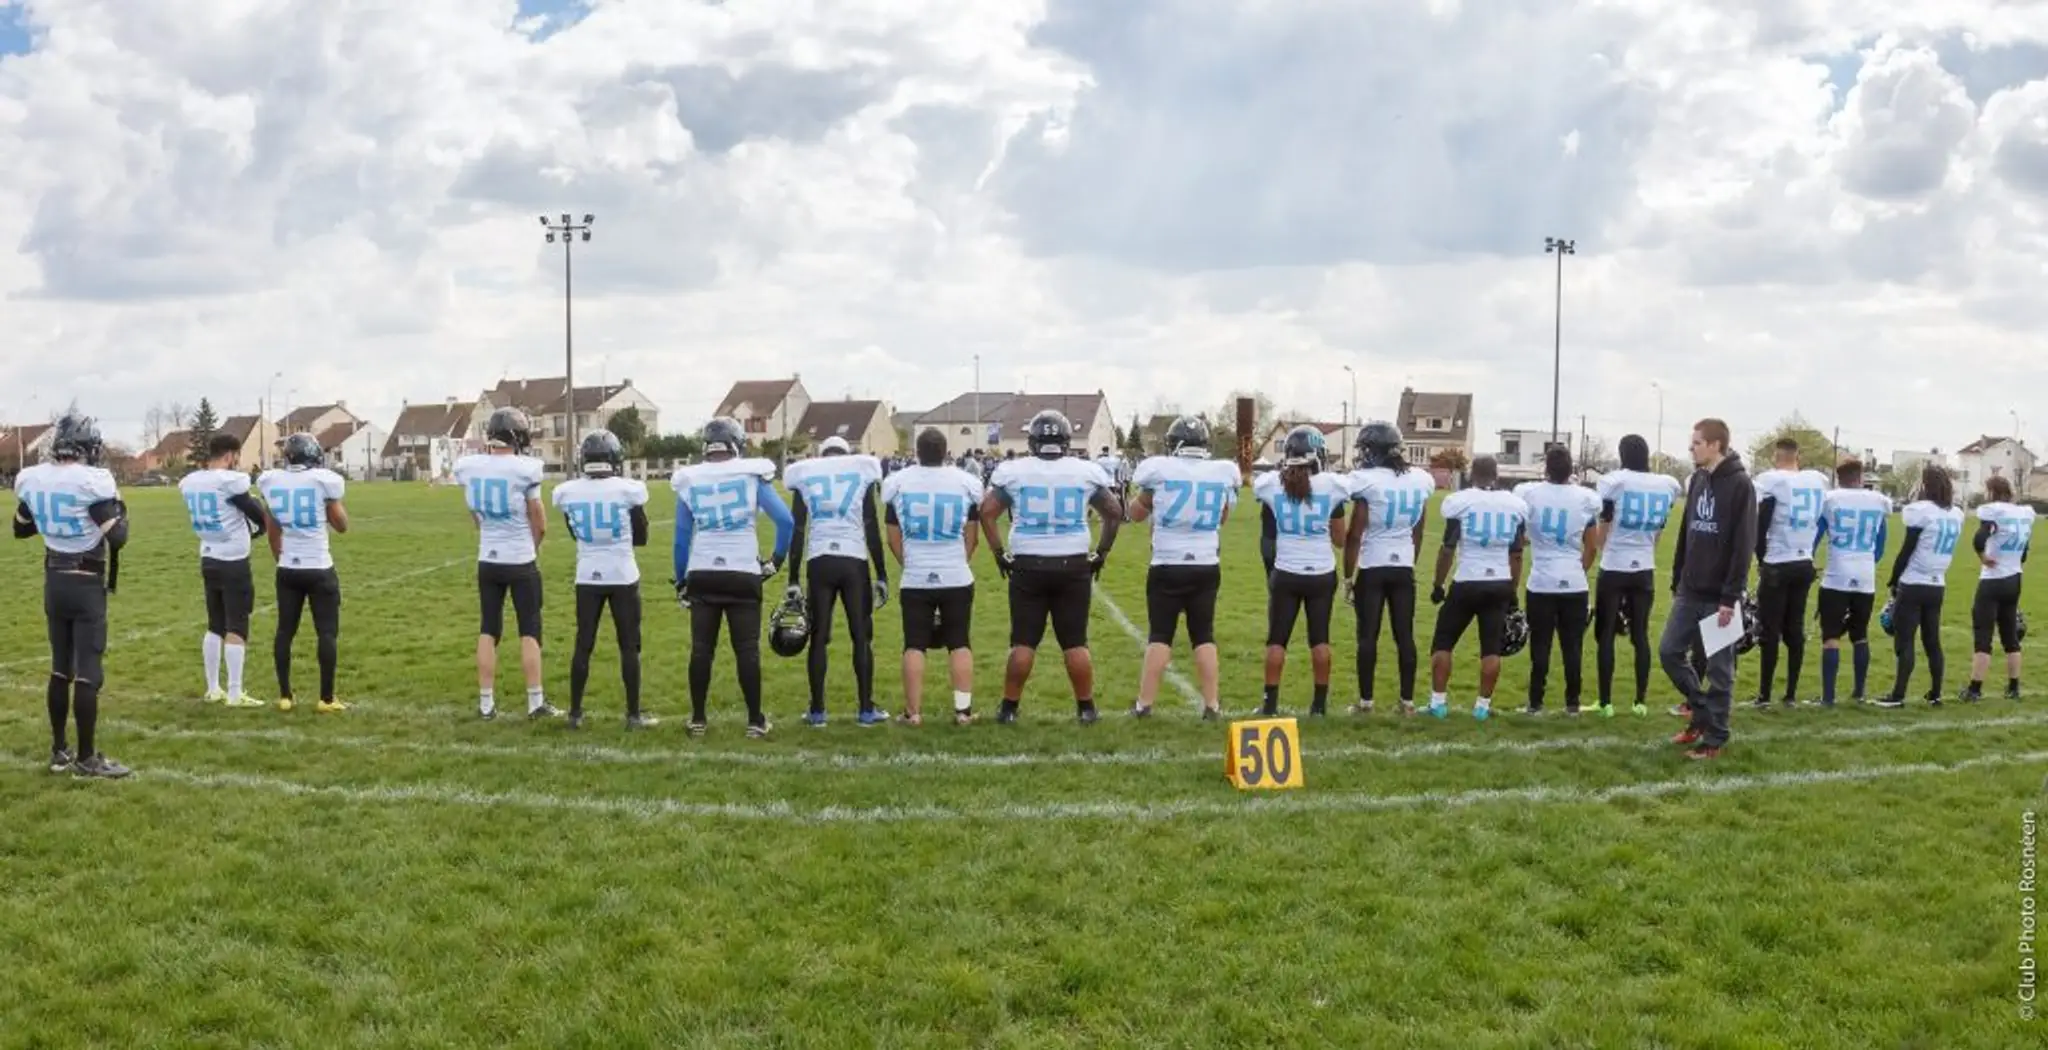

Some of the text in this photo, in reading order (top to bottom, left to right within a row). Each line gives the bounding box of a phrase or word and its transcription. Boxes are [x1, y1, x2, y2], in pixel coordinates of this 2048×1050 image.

[1043, 423, 1059, 436] 59
[23, 491, 85, 538] 45
[270, 488, 318, 529] 28
[470, 478, 511, 519] 10
[690, 479, 749, 531] 52
[804, 472, 861, 519] 27
[1015, 486, 1086, 535] 59
[1161, 480, 1224, 531] 79
[1274, 494, 1330, 535] 82
[1385, 489, 1421, 530] 14
[1621, 491, 1670, 531] 88
[1790, 487, 1823, 531] 21
[1466, 511, 1517, 547] 44
[1542, 507, 1569, 545] 4
[1833, 509, 1884, 551] 50
[1934, 518, 1959, 554] 18
[1240, 726, 1291, 785] 50
